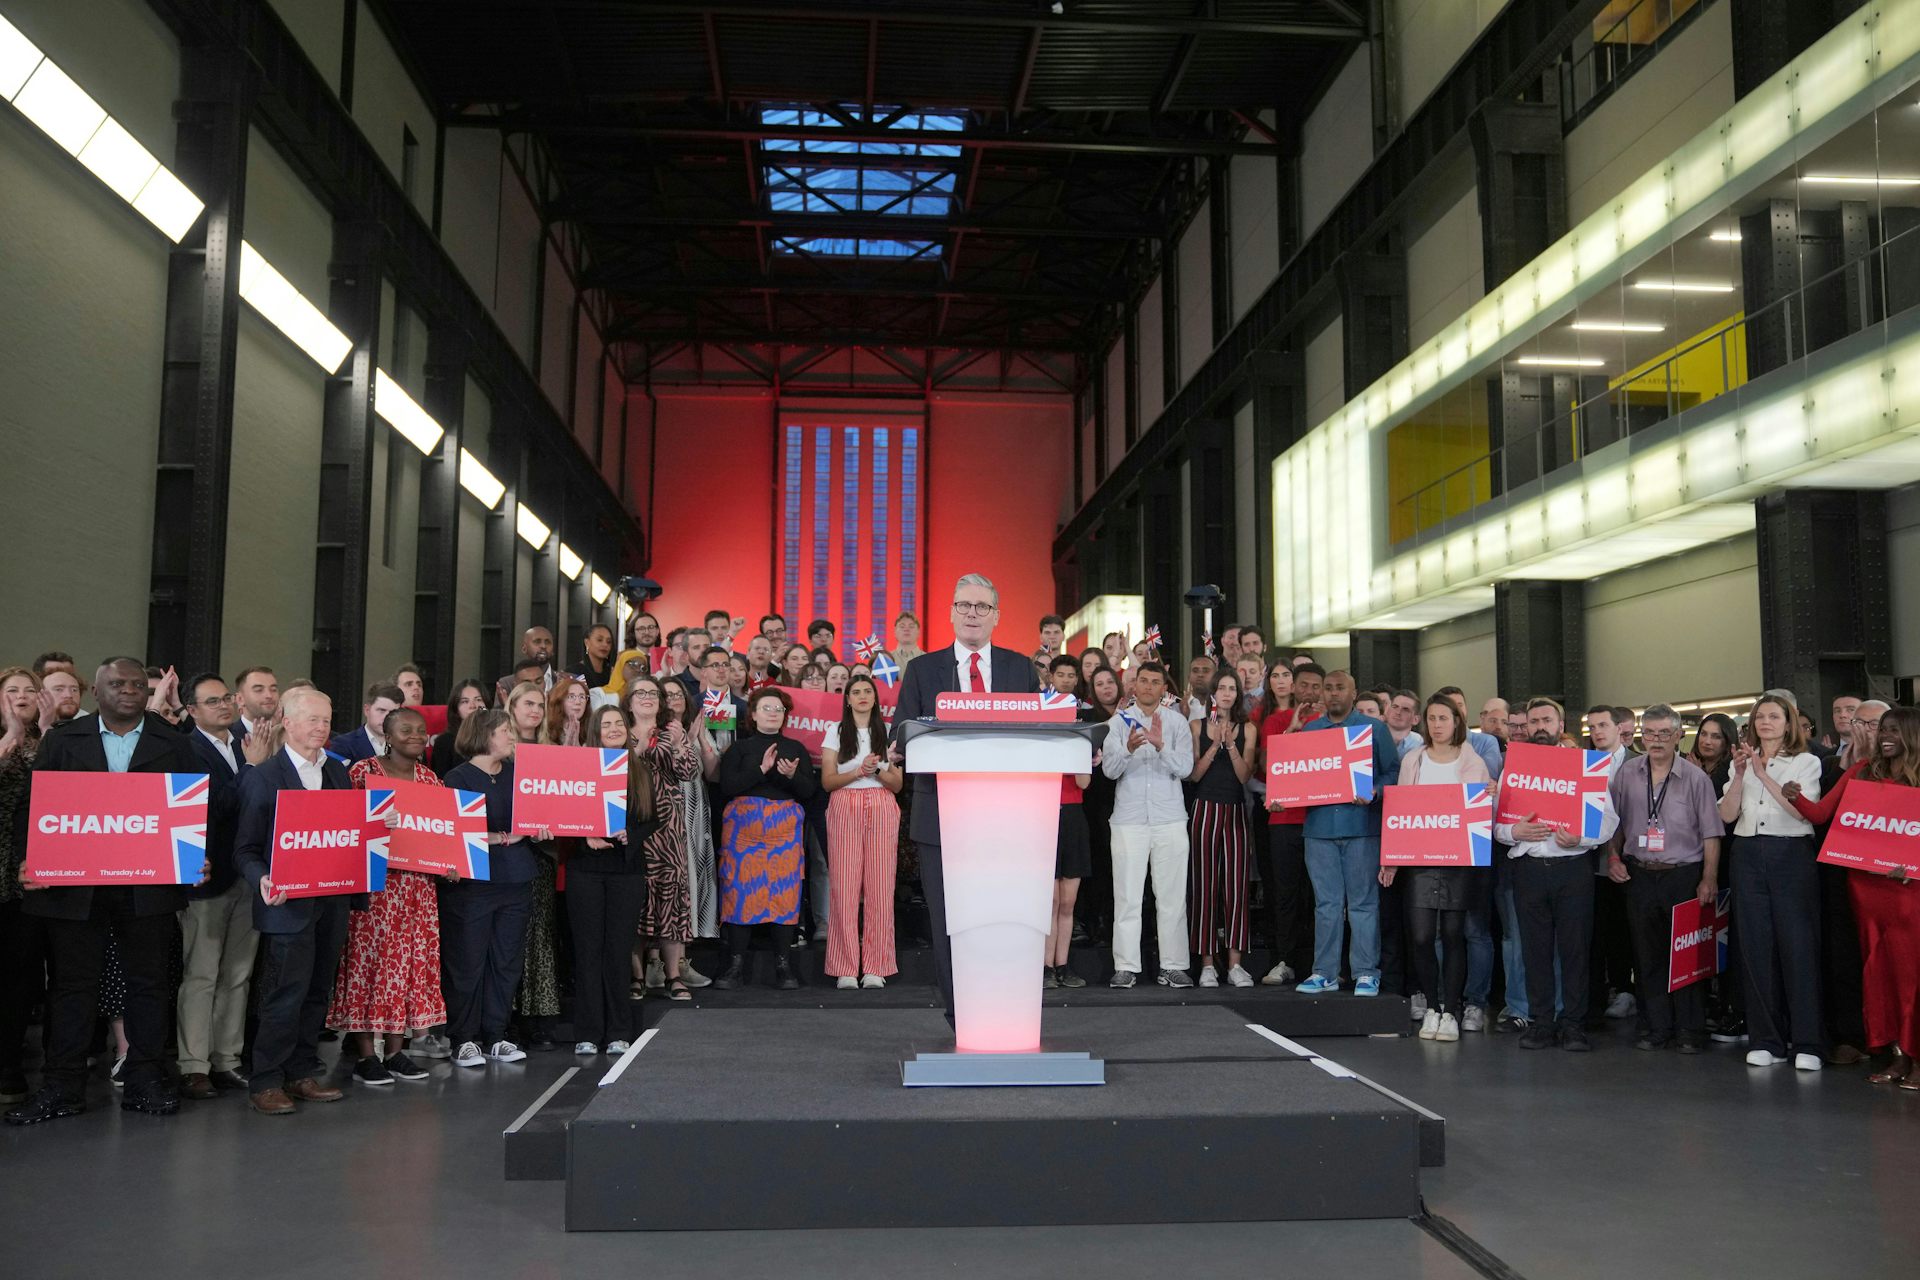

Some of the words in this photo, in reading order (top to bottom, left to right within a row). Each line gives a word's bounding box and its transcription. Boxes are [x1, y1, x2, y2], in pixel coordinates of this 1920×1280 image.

[938, 699, 991, 710] CHANGE
[993, 700, 1038, 711] BEGINS
[786, 715, 832, 732] HAN
[1271, 756, 1342, 775] CHANGE
[519, 778, 596, 796] CHANGE
[1507, 773, 1577, 796] CHANGE
[38, 815, 159, 833] CHANGE
[396, 813, 455, 836] ANGE
[1387, 814, 1460, 829] CHANGE
[1840, 811, 1920, 837] CHANG
[280, 829, 360, 850] CHANGE
[100, 869, 134, 877] Thursday
[140, 869, 156, 877] July
[418, 860, 441, 869] Thursday
[1674, 925, 1713, 952] CHANGE
